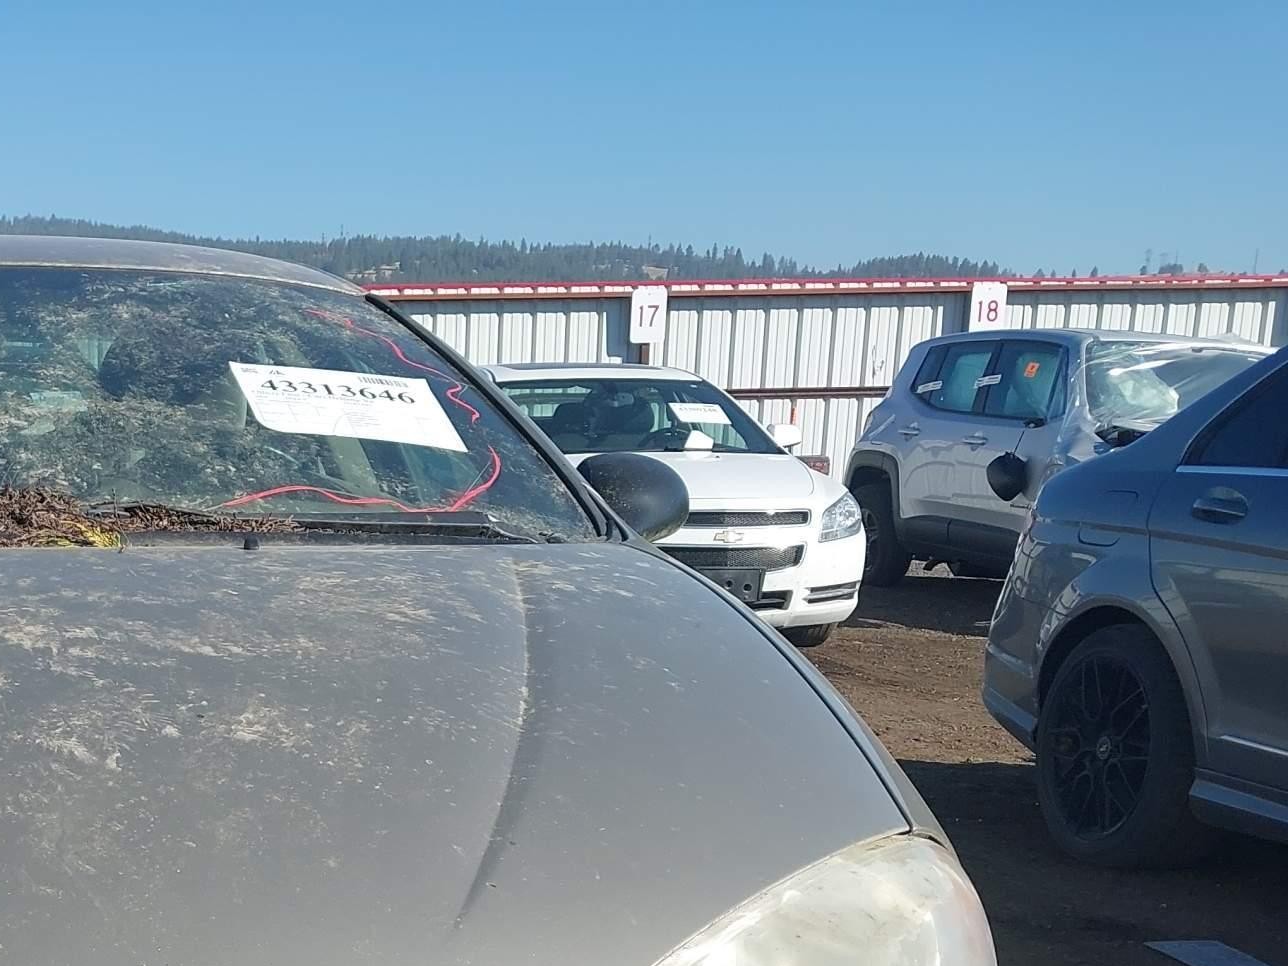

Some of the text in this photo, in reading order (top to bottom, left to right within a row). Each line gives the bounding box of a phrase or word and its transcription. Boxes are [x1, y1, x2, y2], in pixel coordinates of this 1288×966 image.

[639, 304, 660, 328] 17
[977, 300, 999, 323] 18
[261, 378, 416, 404] 43313646
